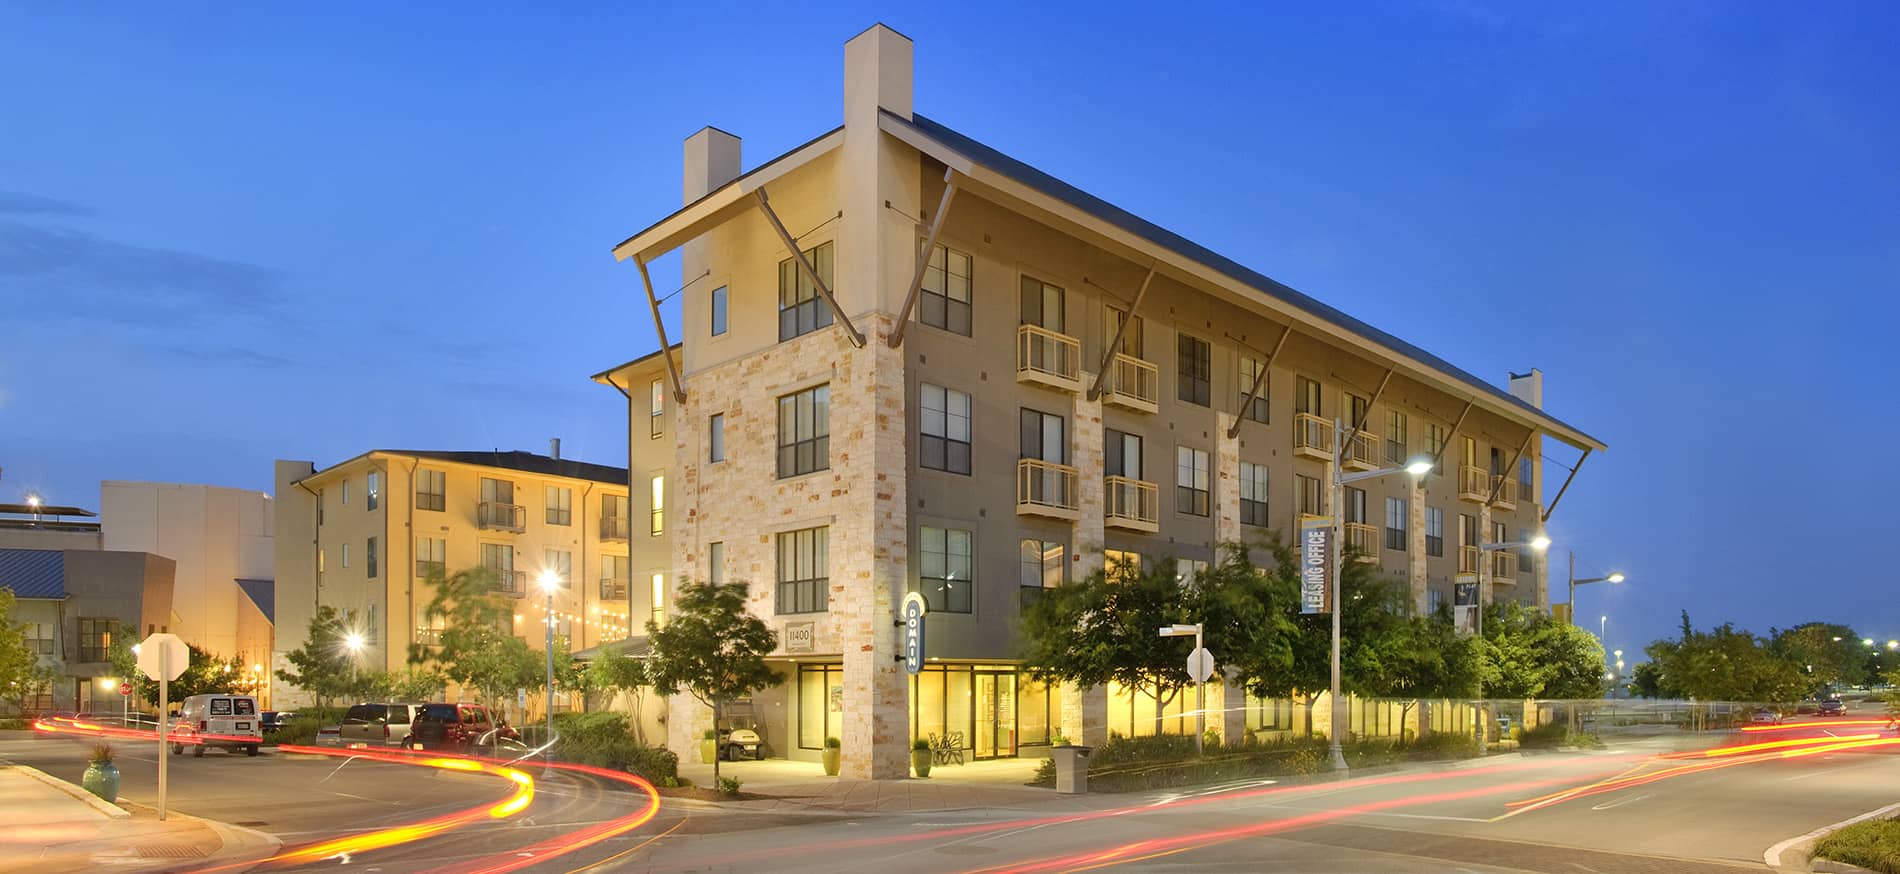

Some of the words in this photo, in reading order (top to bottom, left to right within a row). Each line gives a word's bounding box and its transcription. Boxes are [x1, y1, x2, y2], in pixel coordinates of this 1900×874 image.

[1307, 531, 1325, 565] OFFICE
[1307, 567, 1325, 608] LEASING
[789, 630, 810, 640] 11400
[908, 608, 917, 666] DOMAIN
